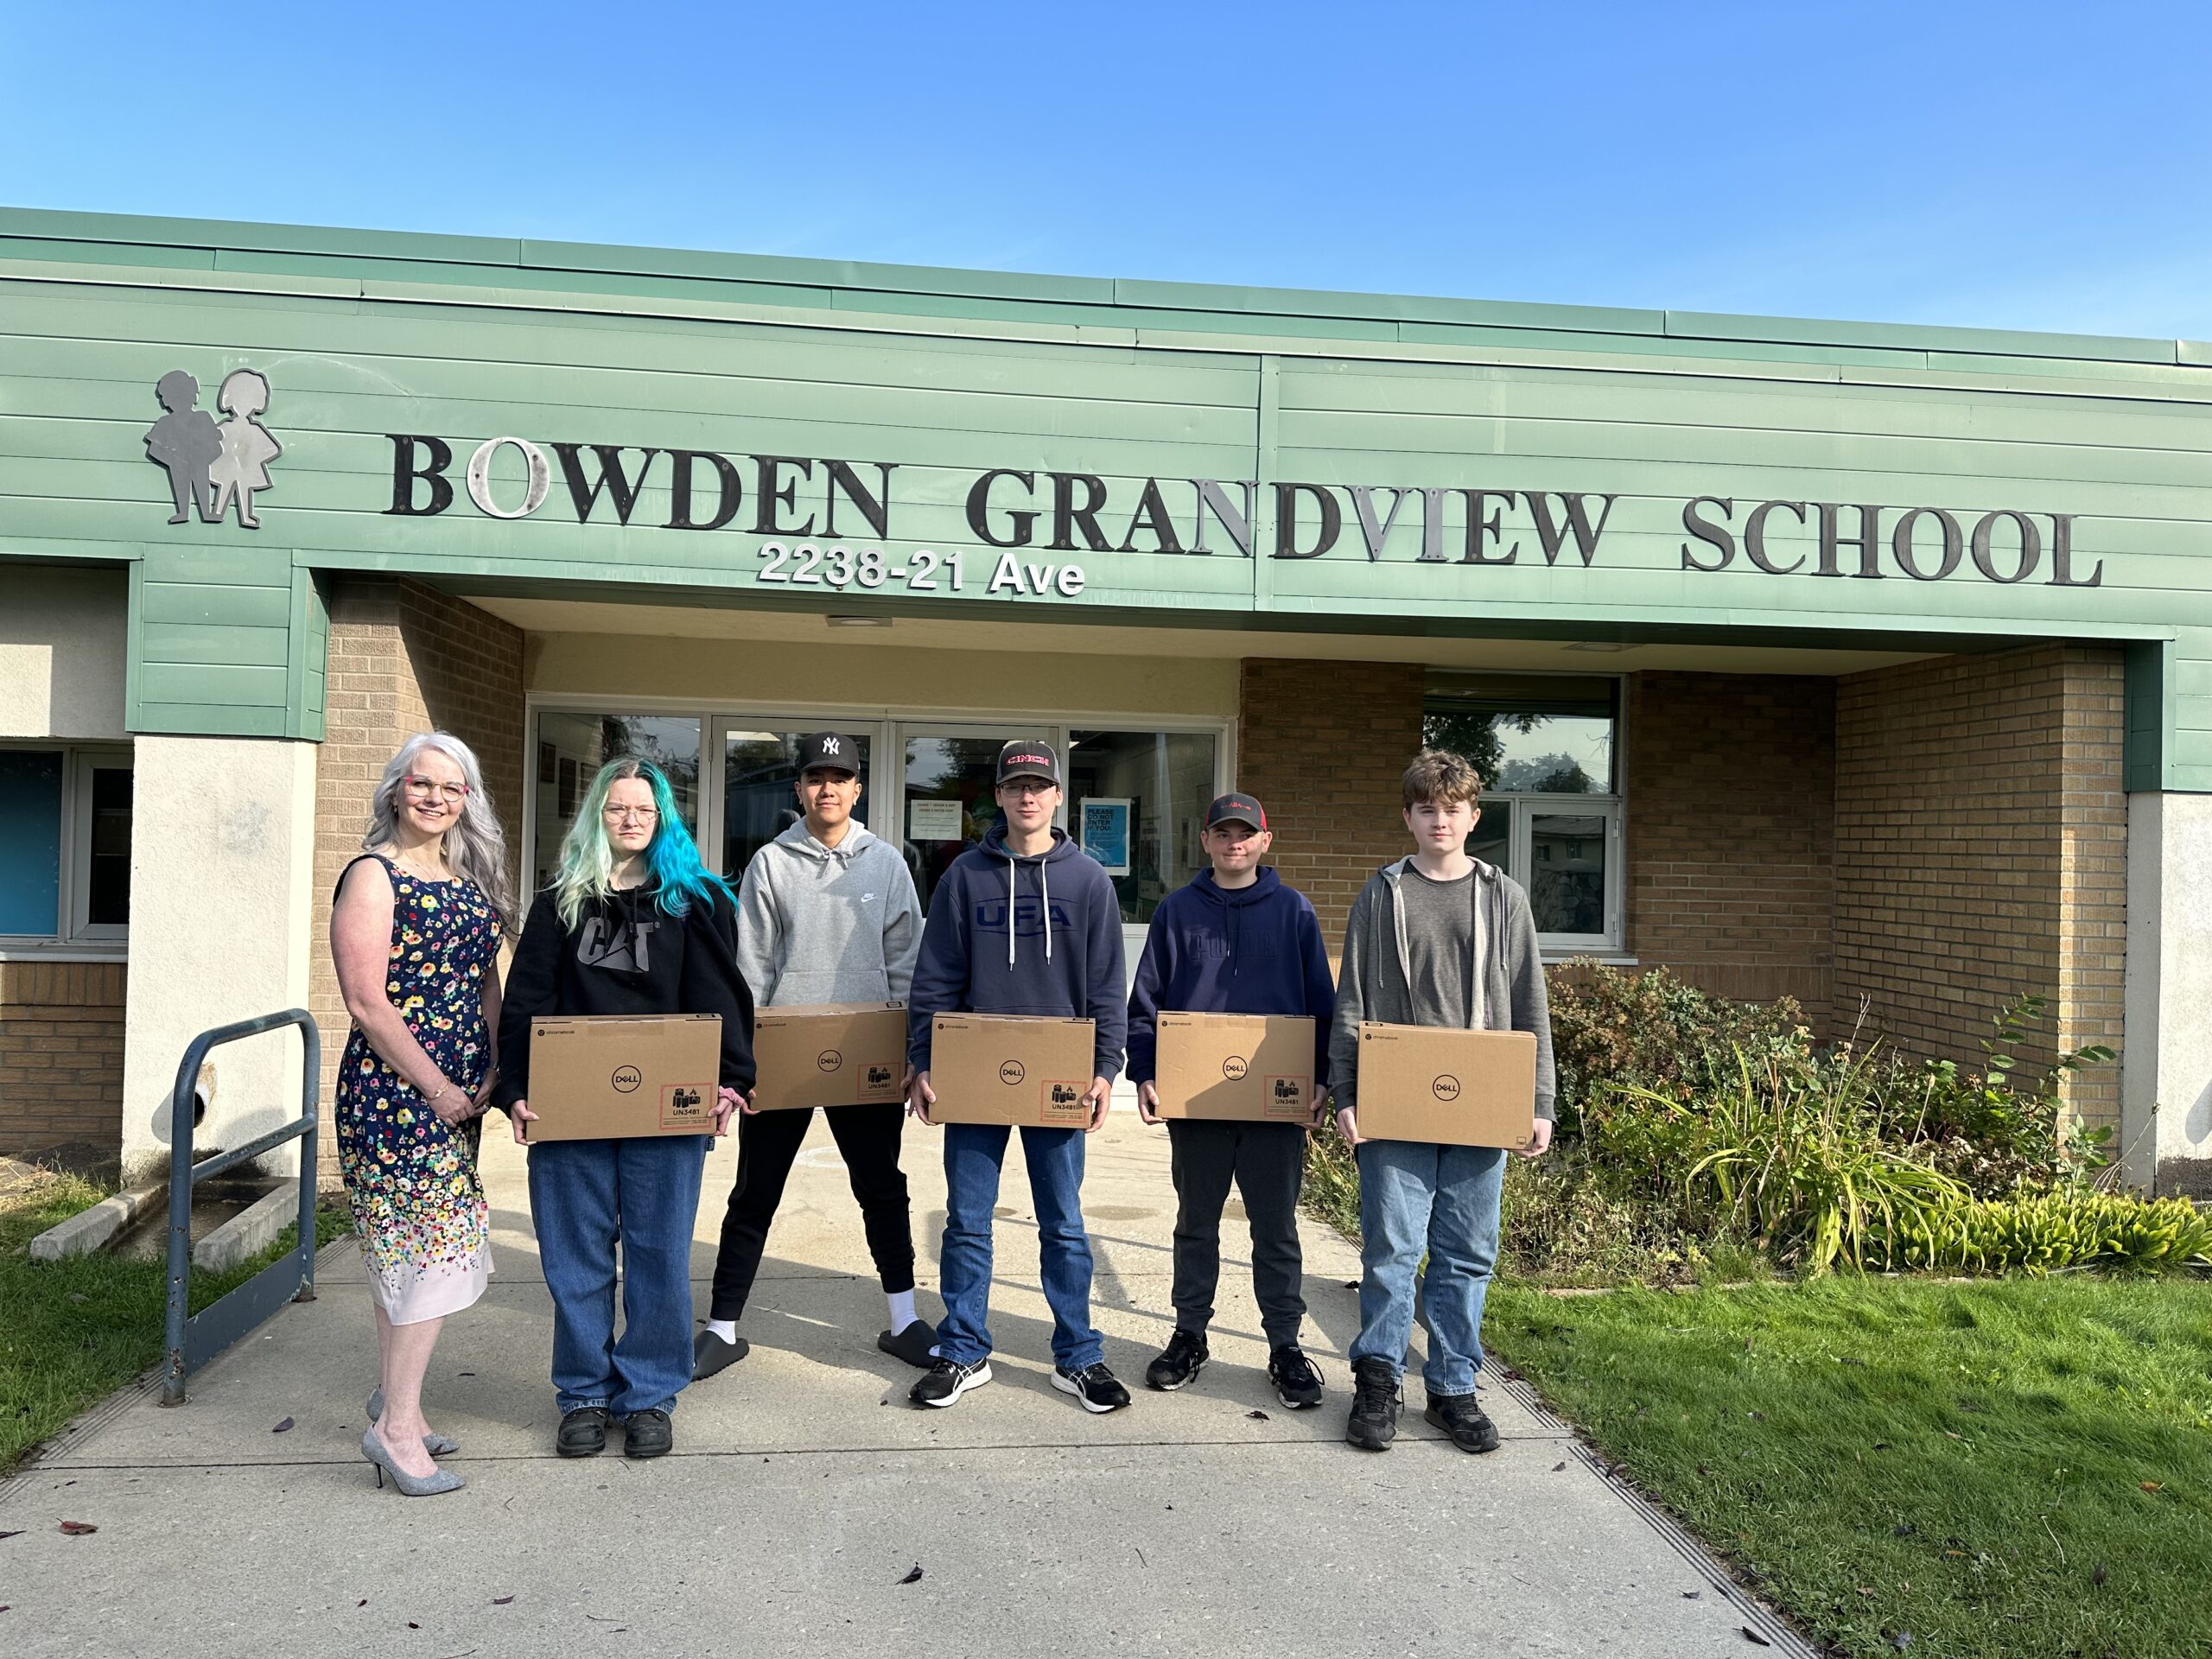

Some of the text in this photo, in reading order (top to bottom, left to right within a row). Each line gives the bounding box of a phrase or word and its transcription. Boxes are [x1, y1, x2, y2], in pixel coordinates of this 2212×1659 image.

[382, 433, 2103, 588] BOWDEN GRANDVIEW SCHOOL
[757, 542, 1086, 597] 2238-21 Ave
[822, 736, 841, 755] NY
[1005, 754, 1051, 766] CINCH
[976, 905, 1071, 927] UFA
[576, 917, 654, 973] CAT
[1435, 1084, 1458, 1092] DELL
